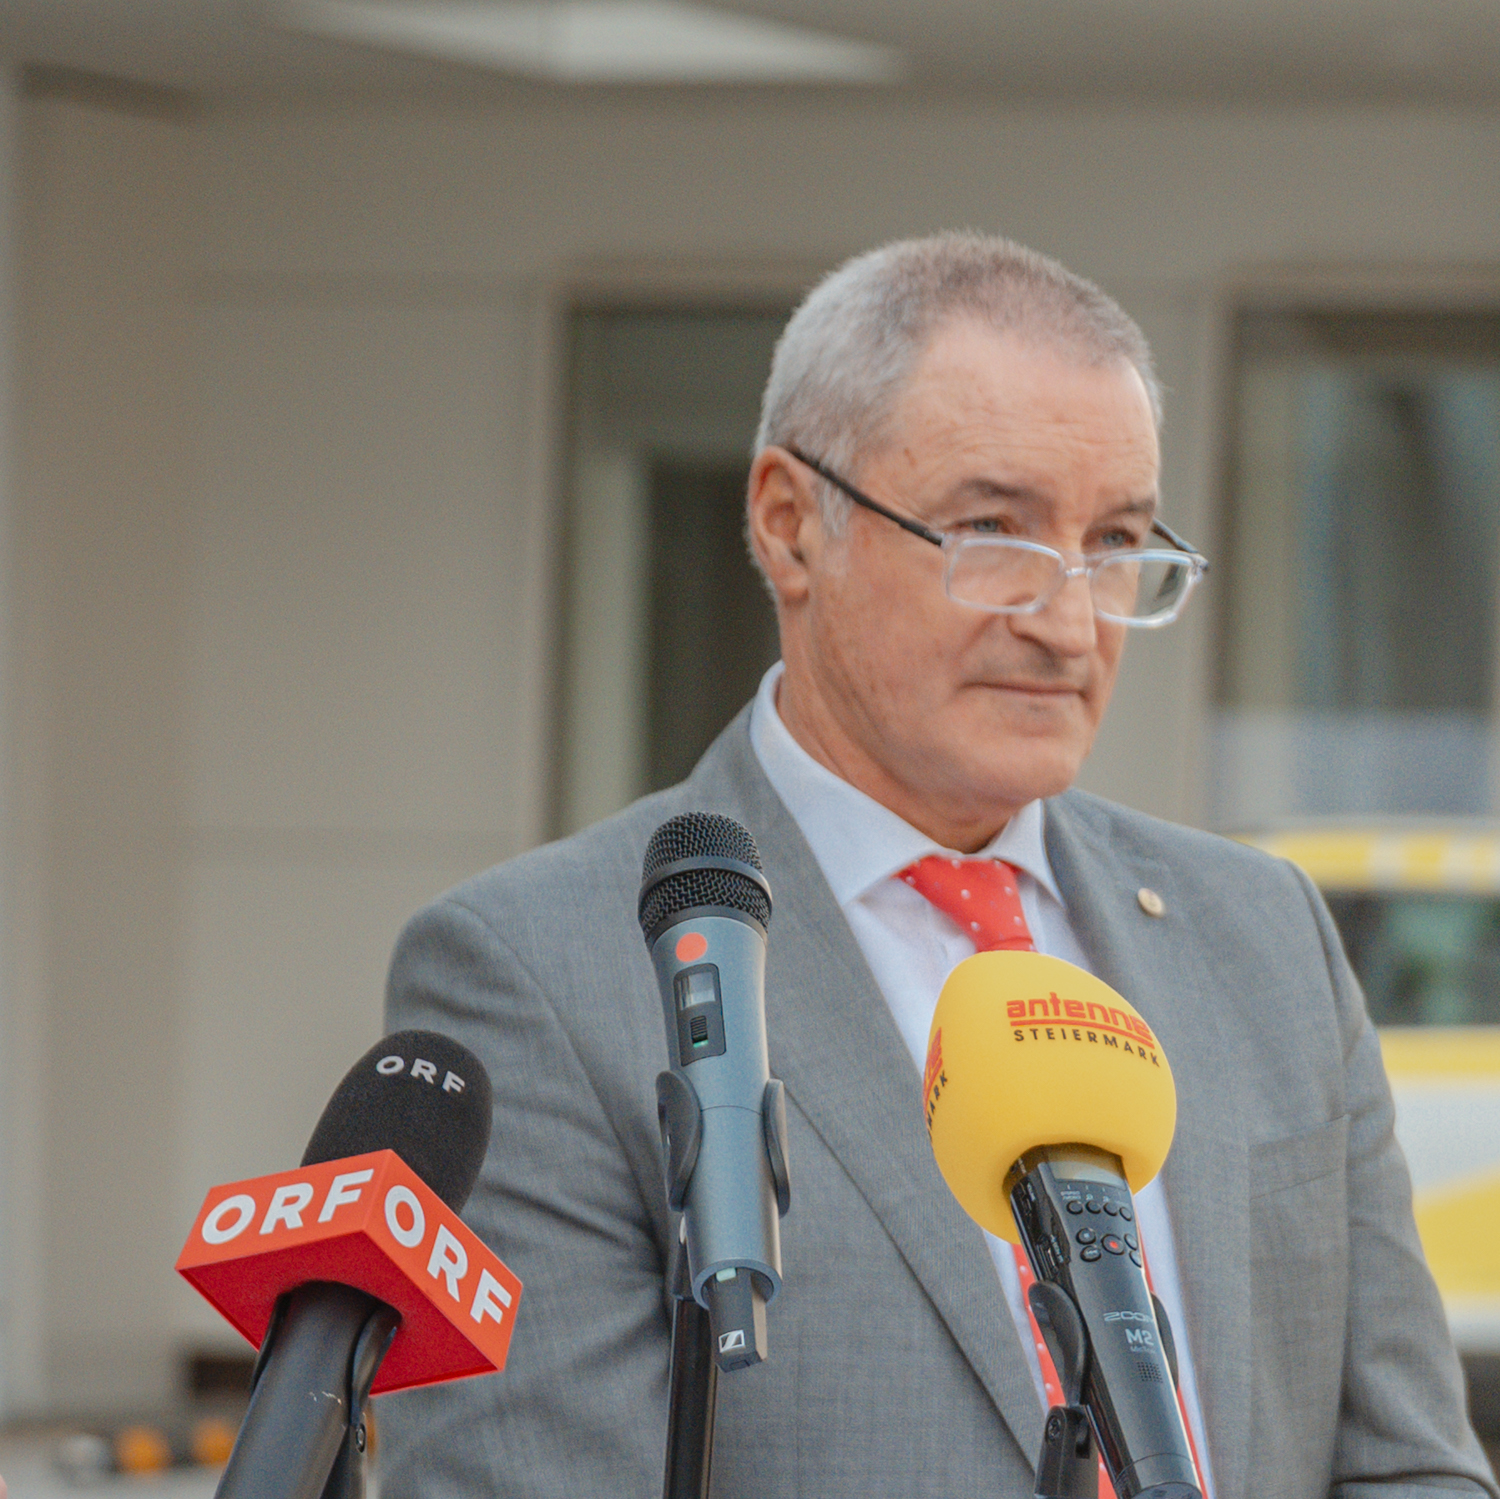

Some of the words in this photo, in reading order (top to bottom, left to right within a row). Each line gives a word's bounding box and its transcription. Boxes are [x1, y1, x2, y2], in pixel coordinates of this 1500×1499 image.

[1006, 991, 1153, 1040] antenne
[1013, 1027, 1161, 1067] STEIERMARK
[376, 1055, 466, 1093] ORF
[201, 1168, 374, 1245] ORF
[384, 1184, 512, 1325] ORF
[1125, 1327, 1155, 1346] M2
